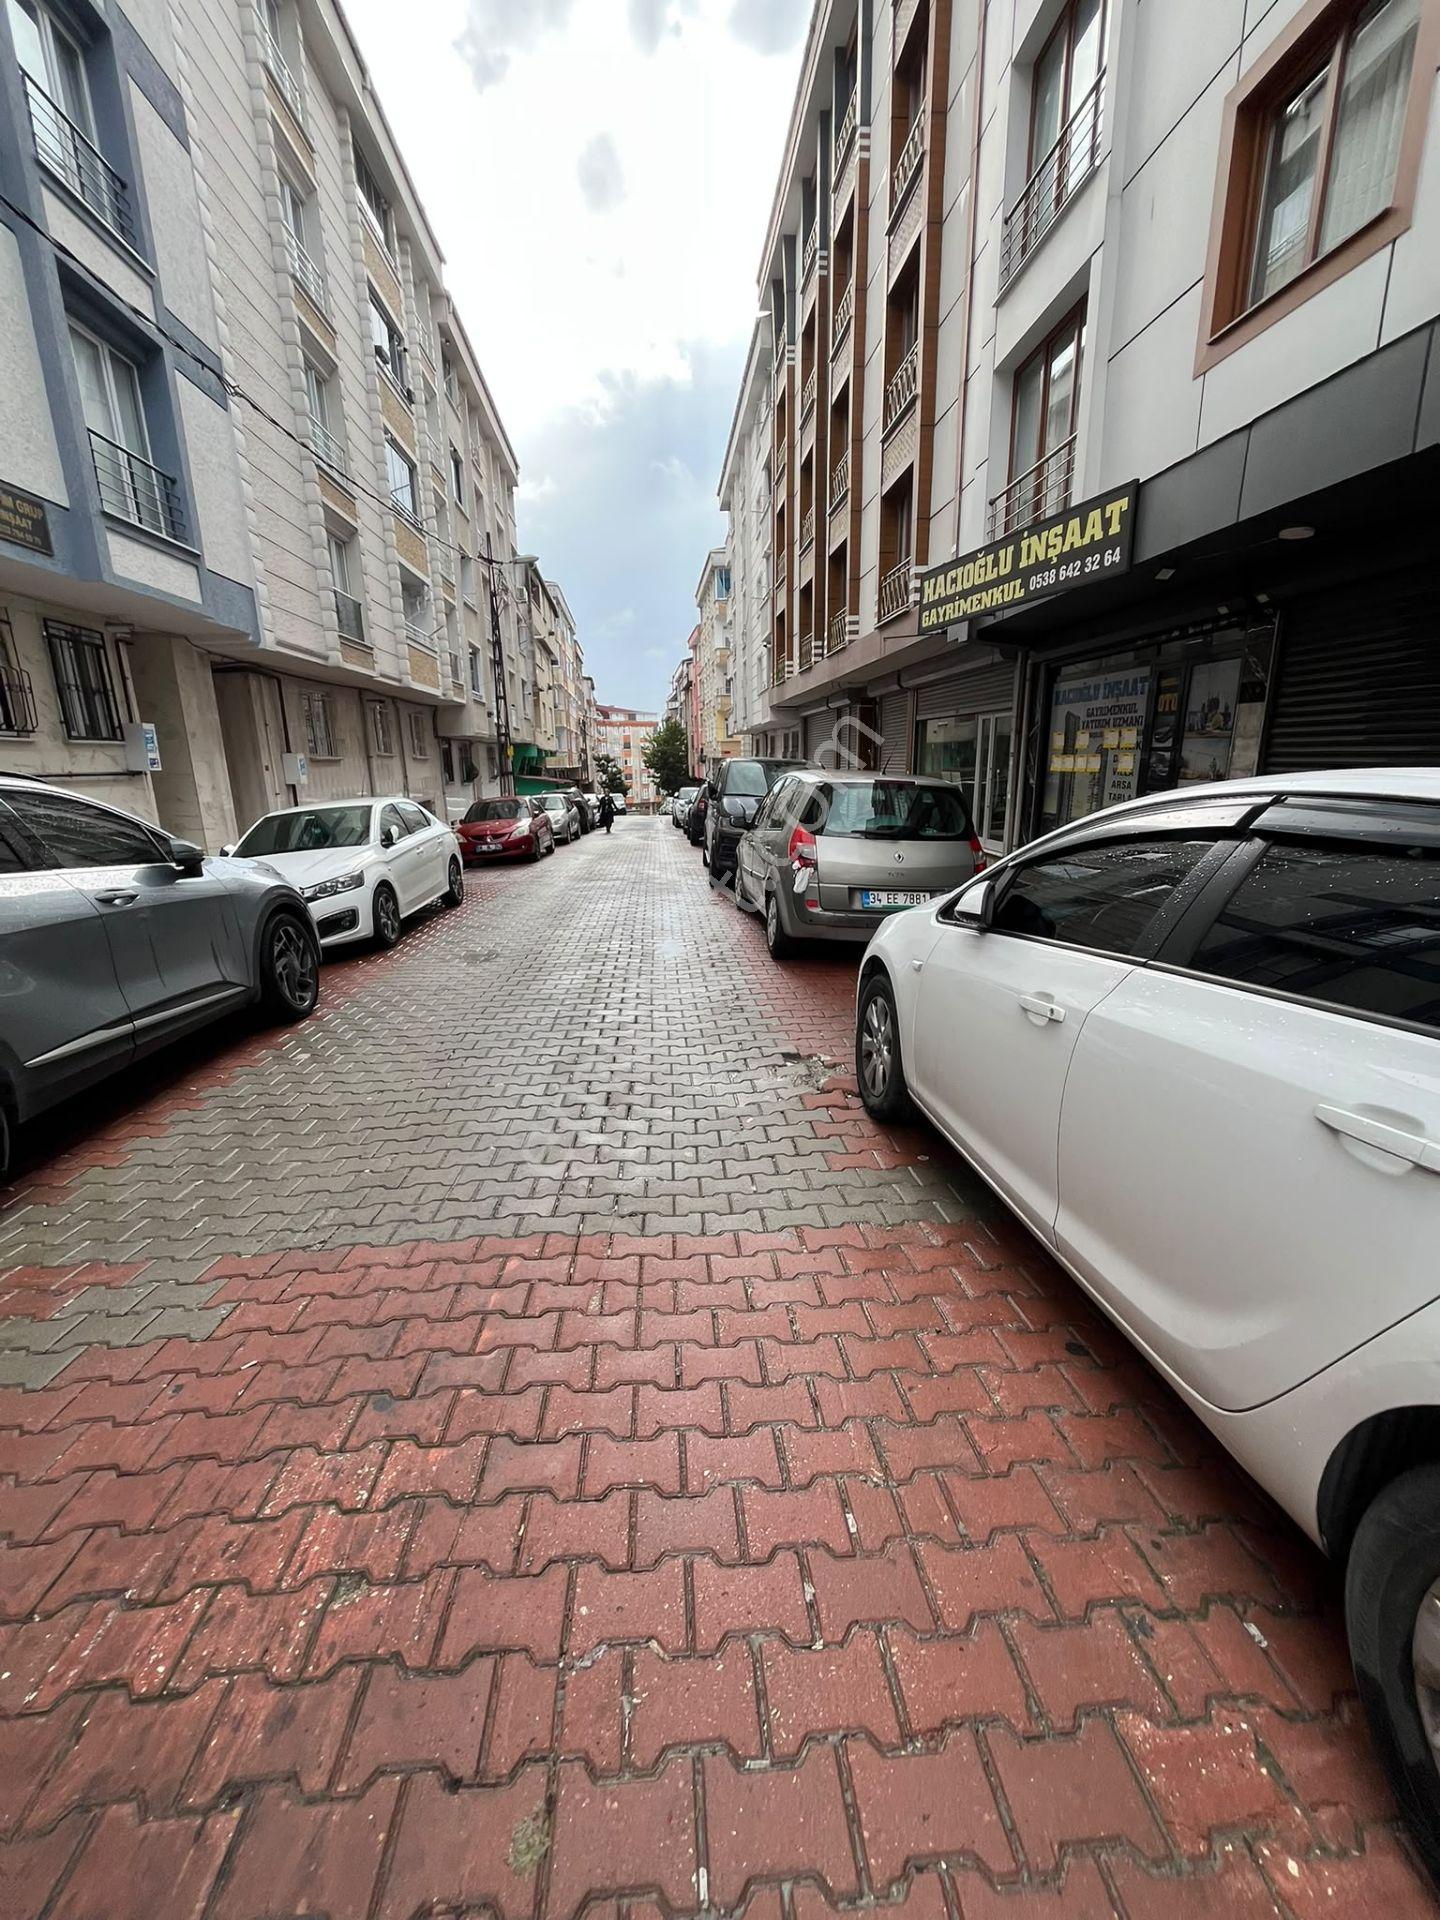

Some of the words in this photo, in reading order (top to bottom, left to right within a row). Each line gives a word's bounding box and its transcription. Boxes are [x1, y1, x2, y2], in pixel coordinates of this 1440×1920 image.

[923, 545, 1014, 604] HACIOĞLU
[1019, 497, 1129, 569] İNŞAAT
[1029, 570, 1056, 591] 0538
[1059, 560, 1081, 581] 642
[1085, 553, 1100, 573] 32
[1104, 546, 1121, 568] 64
[922, 578, 1025, 627] GAYRİMENKUL
[1108, 792, 1132, 801] TARLA
[1111, 780, 1132, 789] ARSA
[870, 893, 882, 904] 34
[886, 893, 898, 904] EE
[903, 893, 927, 905] 7881
